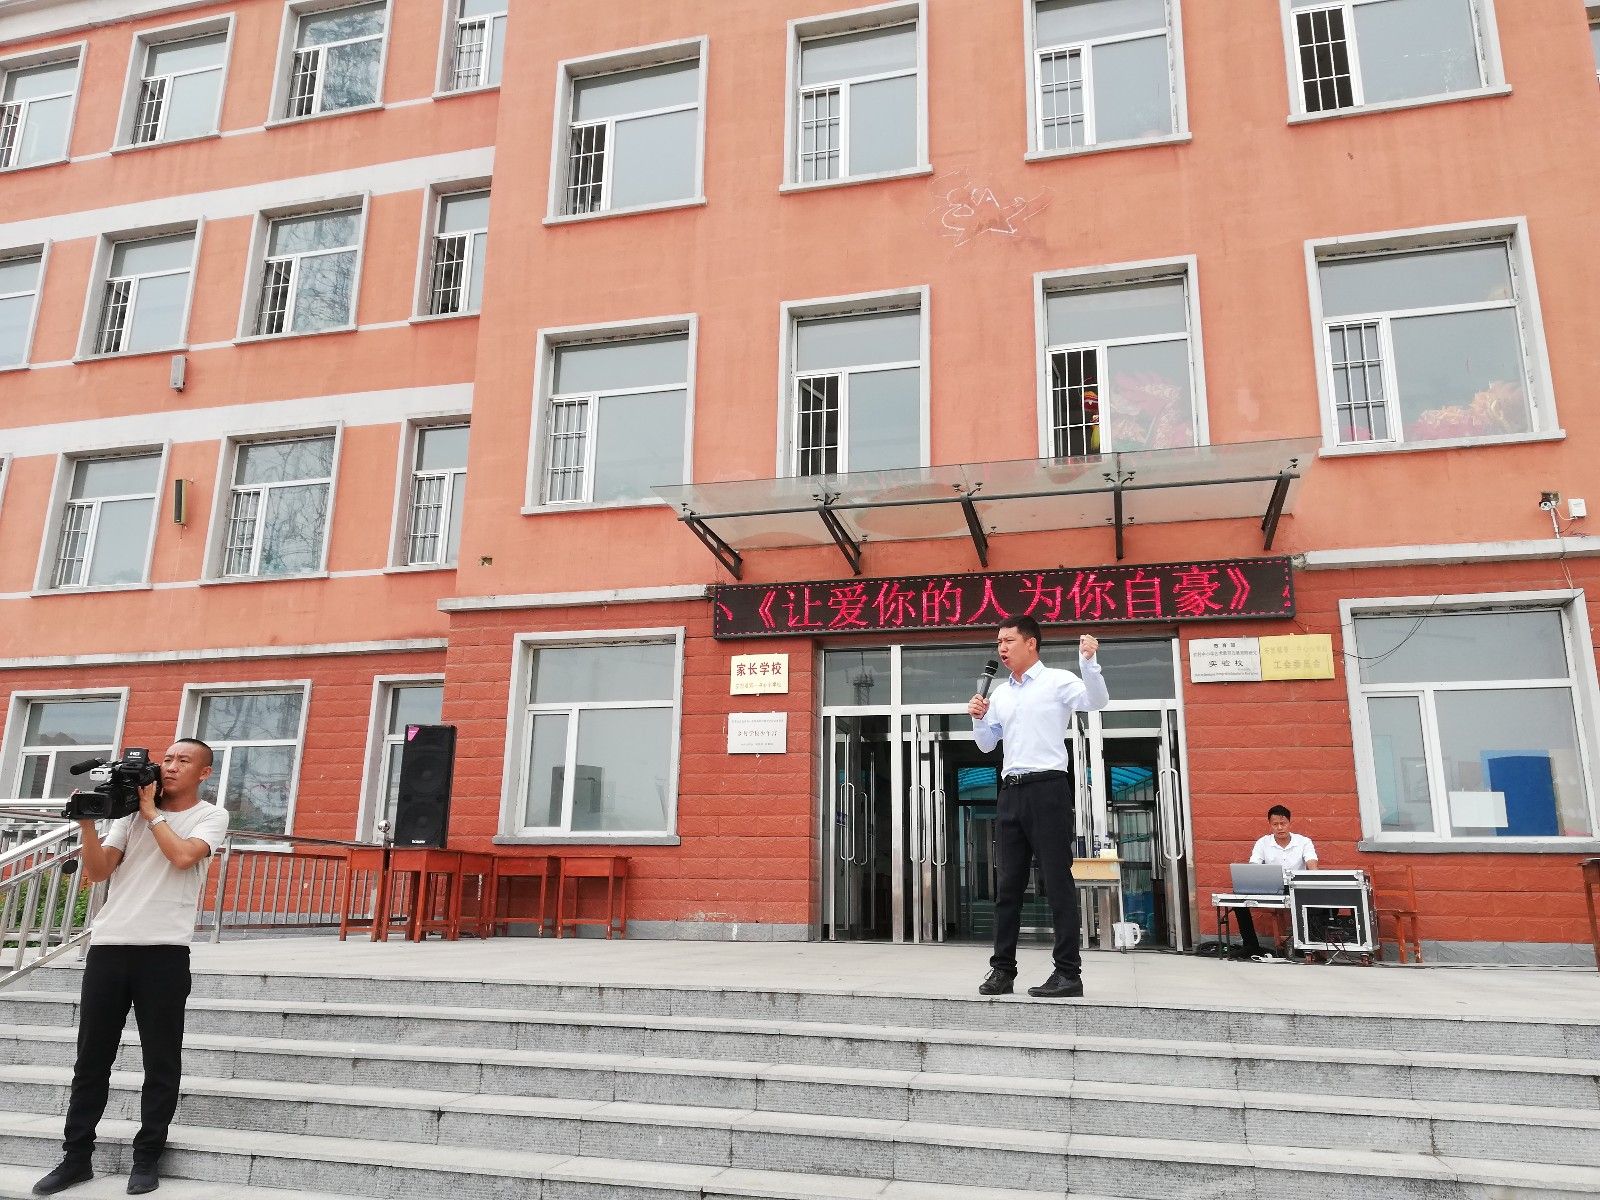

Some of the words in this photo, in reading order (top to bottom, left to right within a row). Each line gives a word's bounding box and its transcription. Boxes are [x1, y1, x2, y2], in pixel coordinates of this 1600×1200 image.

[759, 566, 1251, 629] 《让爱你的人为你自豪》
[736, 661, 782, 677] 家长学校
